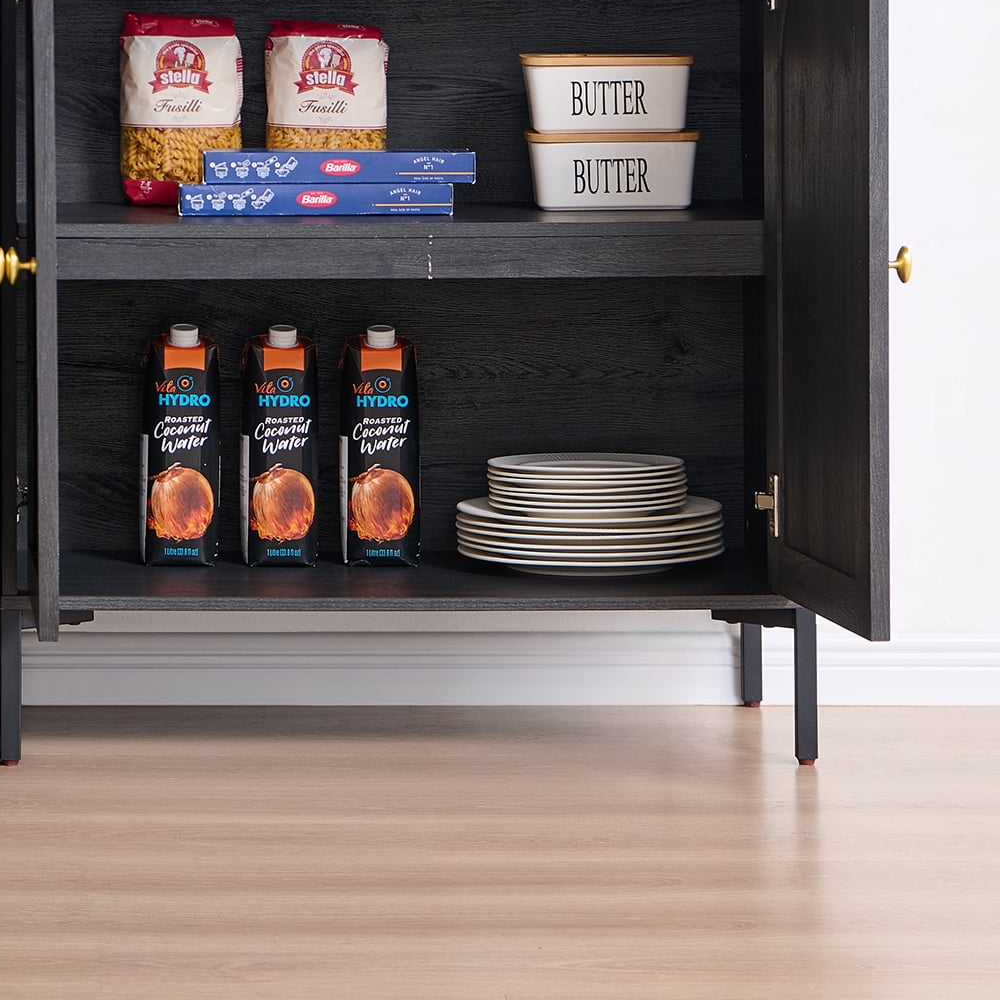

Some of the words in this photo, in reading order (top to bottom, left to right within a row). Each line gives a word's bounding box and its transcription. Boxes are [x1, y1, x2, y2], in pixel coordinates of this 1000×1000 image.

[160, 69, 200, 85] stella
[305, 70, 346, 86] stella
[154, 99, 203, 113] Fusilli
[571, 80, 648, 116] BUTTER
[299, 99, 348, 114] Fusilli
[325, 163, 358, 172] Barilla
[573, 158, 651, 194] BUTTER
[301, 194, 334, 204] Barilla
[159, 393, 211, 407] HYDRO
[259, 394, 311, 407] HYDRO
[356, 395, 409, 408] HYDRO
[265, 416, 304, 424] ROASTED
[362, 417, 402, 425] ROASTED
[154, 418, 213, 439] Coconut
[254, 418, 312, 440] Coconut
[352, 419, 411, 440] Coconut
[161, 434, 208, 453] Water
[262, 435, 309, 454] Water
[360, 435, 407, 455] Water
